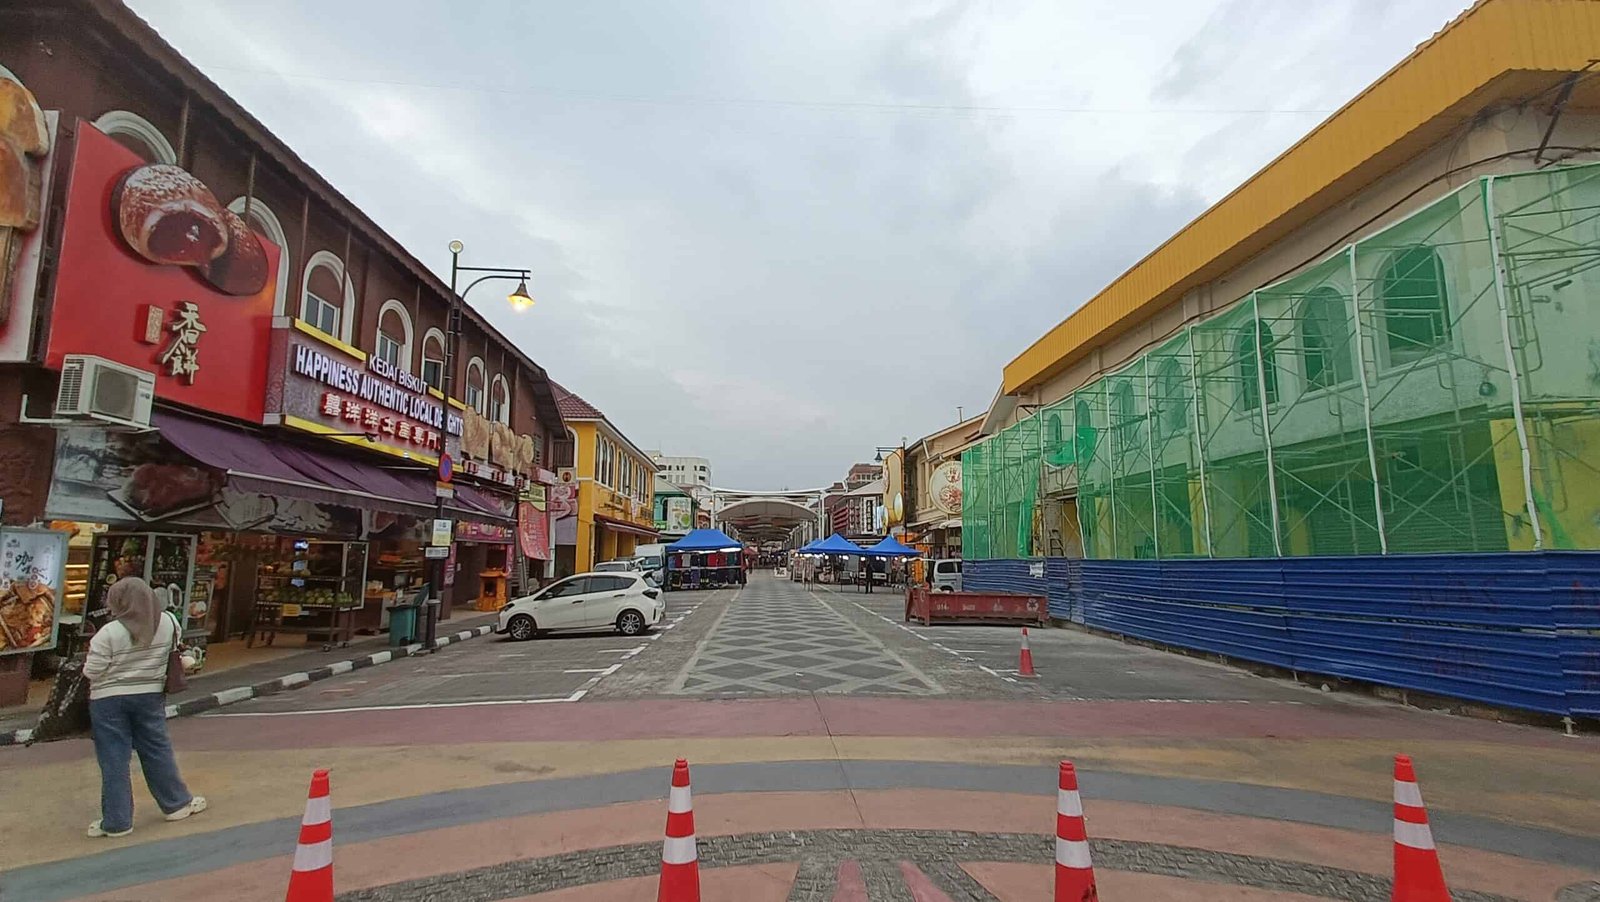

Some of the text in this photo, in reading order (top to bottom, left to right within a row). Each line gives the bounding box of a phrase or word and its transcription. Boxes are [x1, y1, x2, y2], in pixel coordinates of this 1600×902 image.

[295, 344, 464, 437] HAPPINESS AUTHENTIC LOCAL DEGHTS
[369, 353, 428, 395] KEDAI BISKUT
